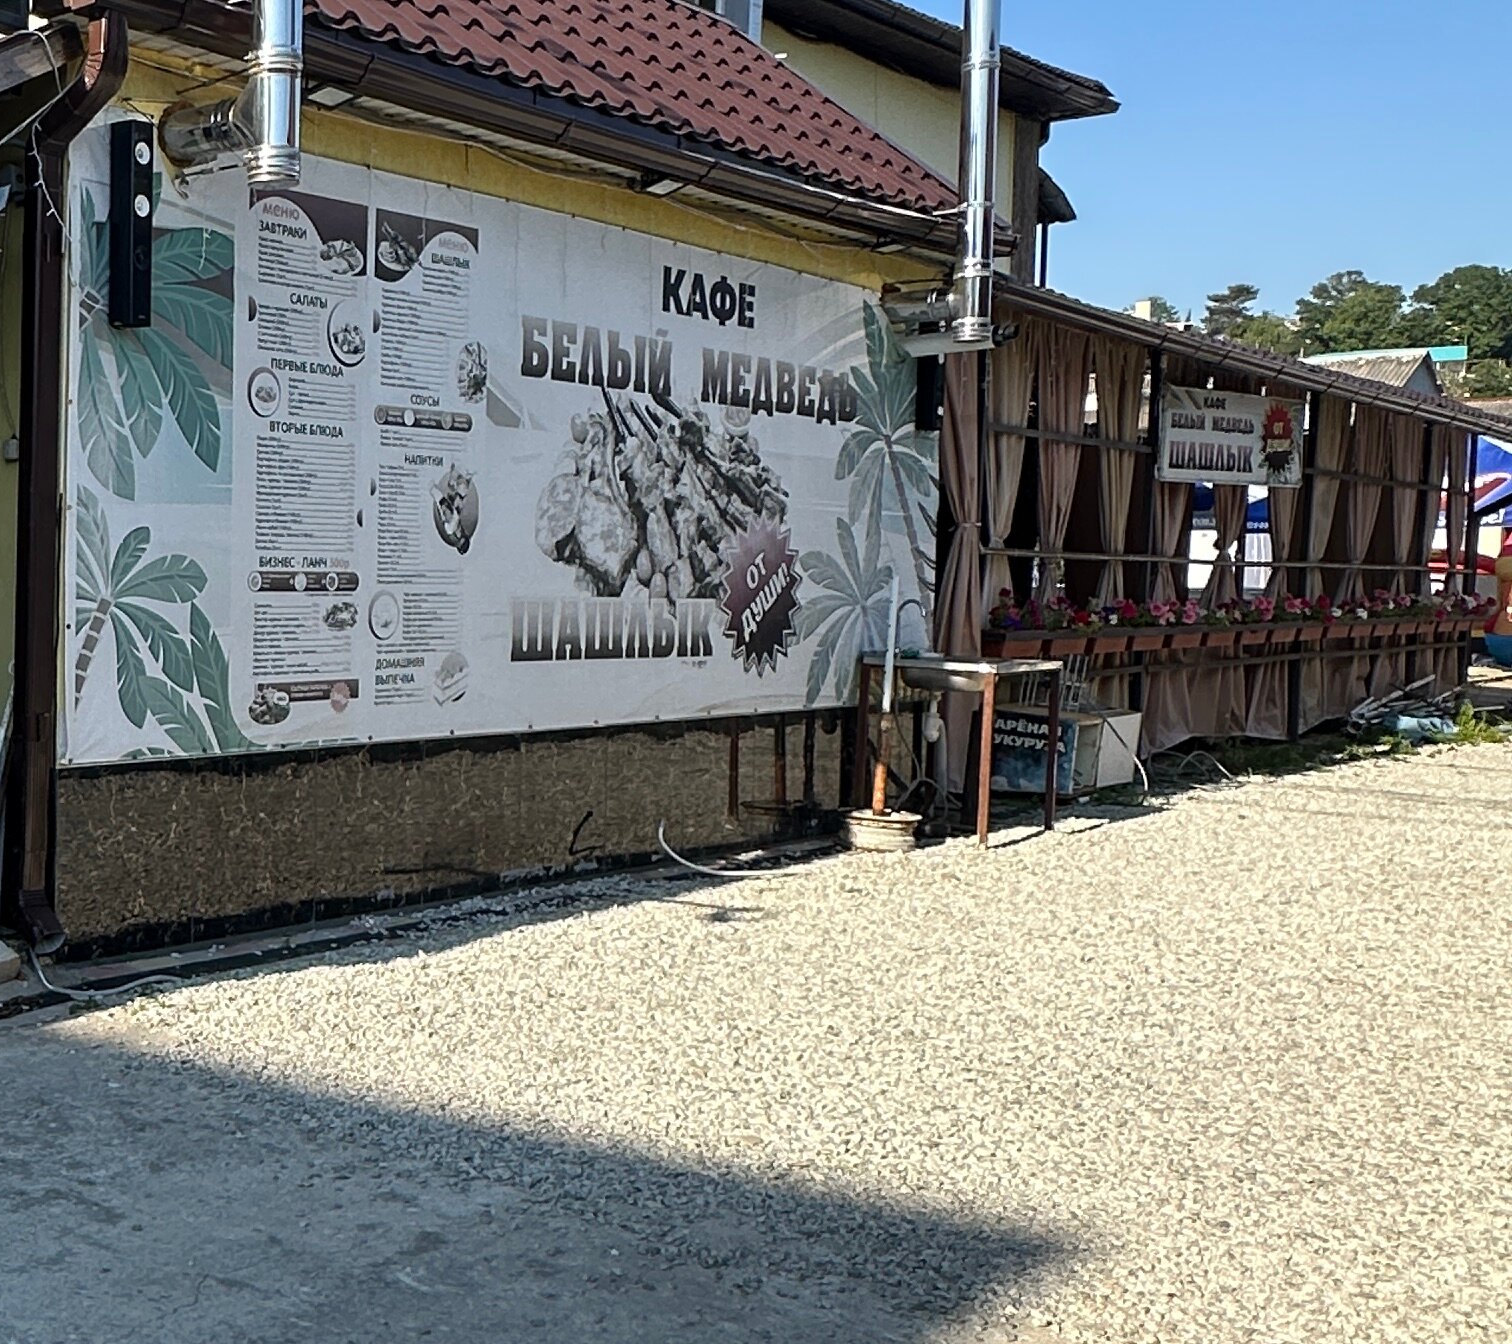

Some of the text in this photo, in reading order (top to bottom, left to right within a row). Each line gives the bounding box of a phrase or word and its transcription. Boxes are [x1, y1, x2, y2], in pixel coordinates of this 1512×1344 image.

[262, 203, 300, 220] МЕНЮ
[259, 220, 308, 240] ЗАВТРАКИ
[289, 293, 328, 309] САЛАТЫ
[662, 265, 756, 328] КАФЕ
[271, 357, 344, 377] ПЕРВЫЕ БЛЮДА
[520, 314, 672, 397] БЕЛЫЙ
[701, 347, 858, 425] МЕДВЕДЬ
[1203, 396, 1227, 410] КАФЕ
[269, 421, 344, 438] ВТОРЫЕ БЛЮДА
[1170, 412, 1206, 431] БЕЛЫЙ
[1169, 440, 1253, 473] ШАШЛЫК
[259, 556, 296, 568] БИЗНЕС
[301, 556, 327, 568] ЛАНЧ
[746, 552, 766, 589] ОТ
[741, 562, 790, 643] ДУШИ!
[511, 597, 716, 662] ШАШЛЫК
[994, 718, 1063, 737] АРЁНА
[993, 733, 1066, 754] УКУРУА
